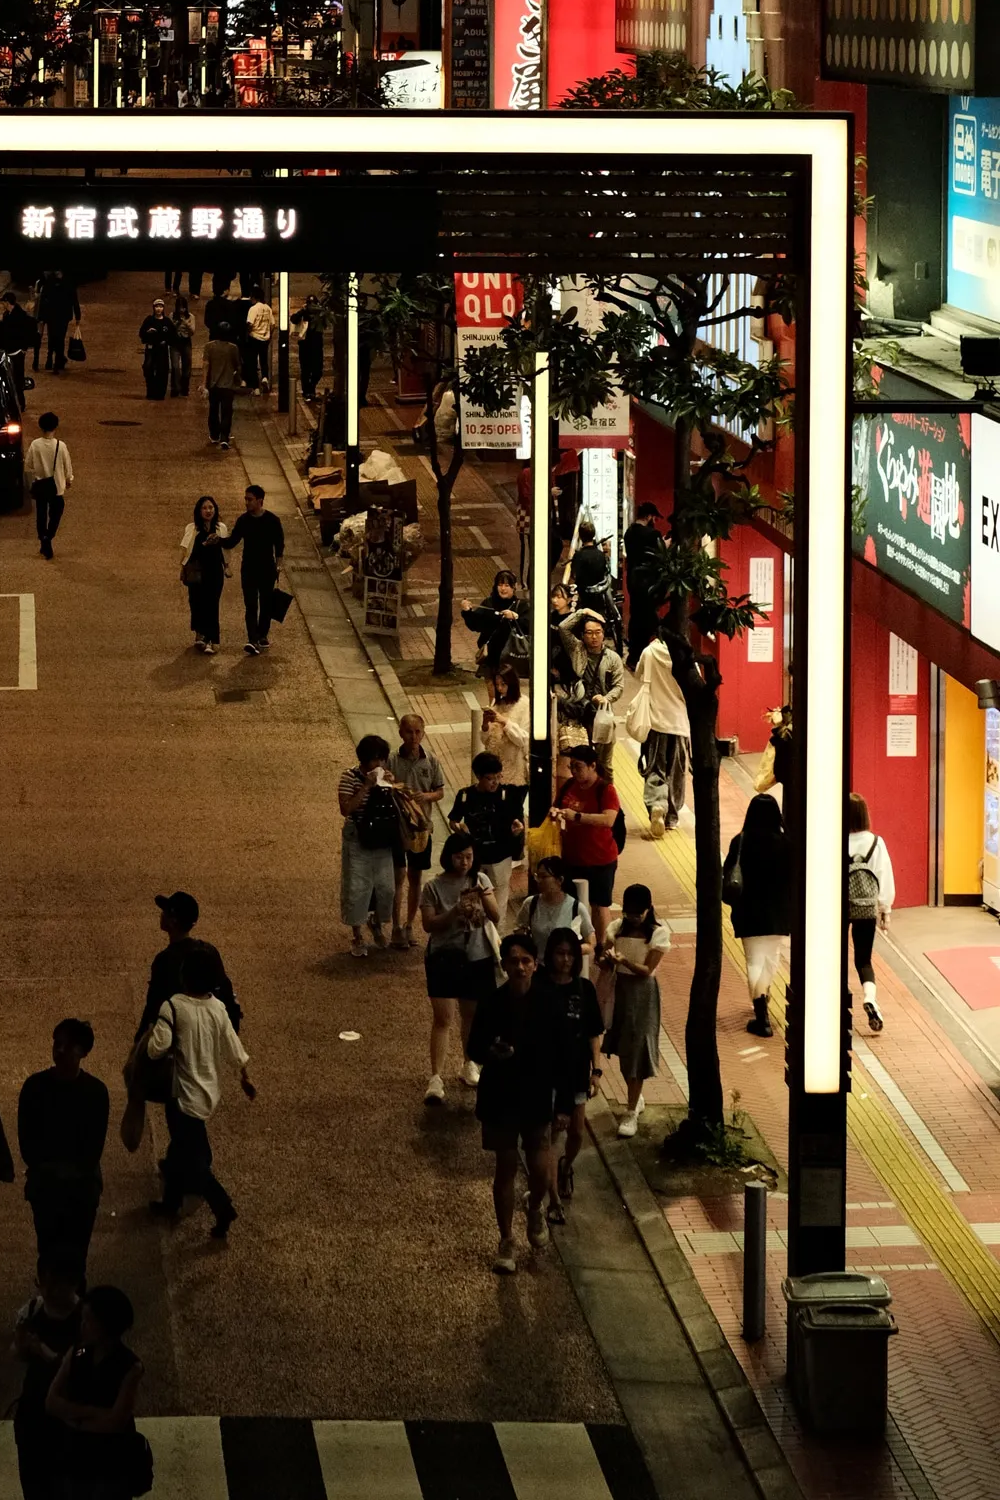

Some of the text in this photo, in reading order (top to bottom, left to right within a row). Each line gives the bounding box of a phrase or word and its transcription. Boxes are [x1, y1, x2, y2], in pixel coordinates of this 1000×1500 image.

[22, 206, 297, 239] 新宿武蔵野通り
[463, 294, 516, 323] QLO
[462, 334, 496, 342] SHINJUKU
[589, 417, 617, 427] 新宿区
[465, 424, 493, 435] 10.25
